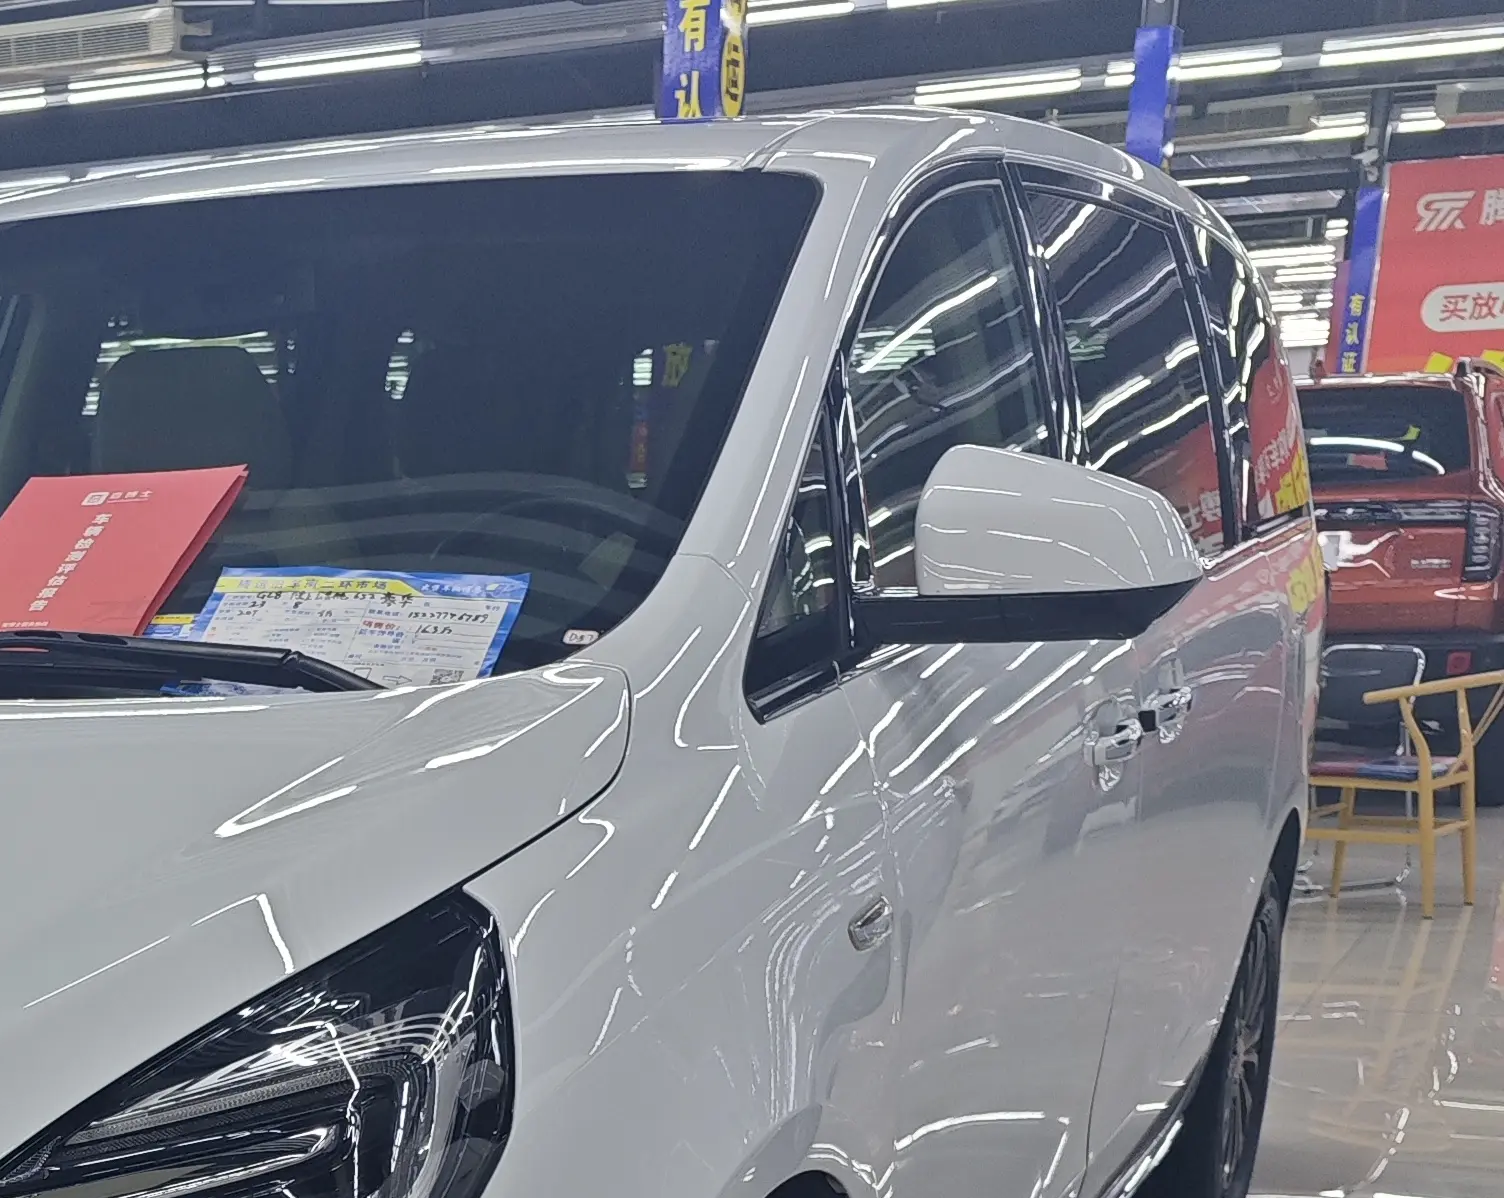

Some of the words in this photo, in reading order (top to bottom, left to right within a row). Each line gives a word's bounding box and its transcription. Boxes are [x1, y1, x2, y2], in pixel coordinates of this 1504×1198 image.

[1439, 291, 1504, 322] 买放
[29, 513, 113, 612] 车辆检测评估报告
